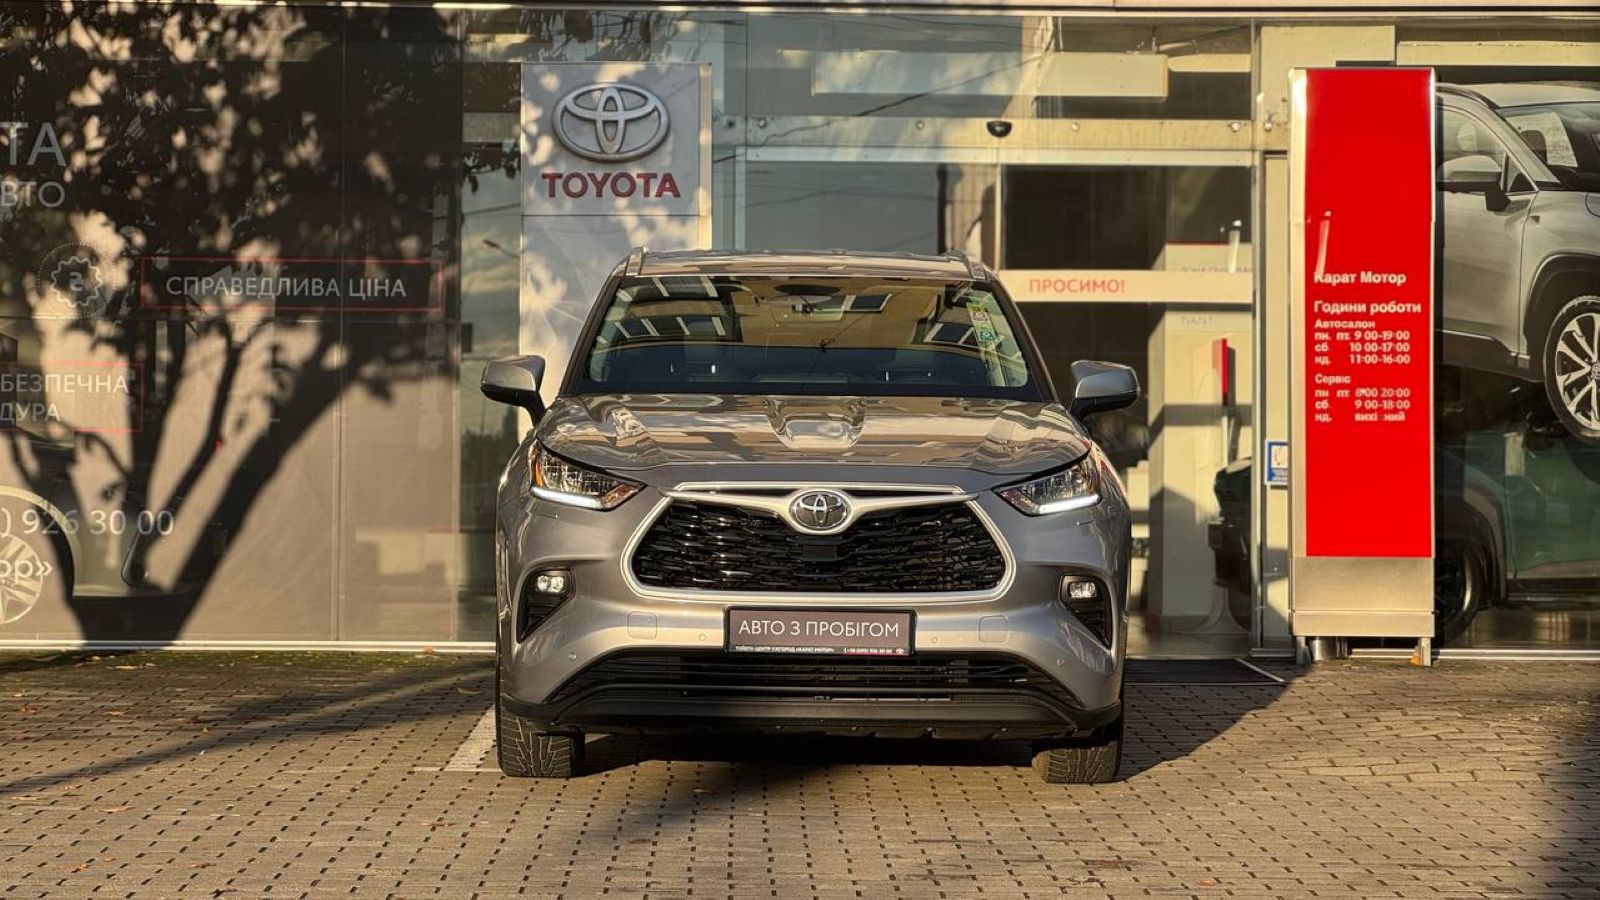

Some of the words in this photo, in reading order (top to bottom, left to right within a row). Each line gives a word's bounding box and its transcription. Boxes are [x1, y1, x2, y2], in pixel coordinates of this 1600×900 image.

[541, 172, 680, 198] TOYOTA
[1029, 278, 1126, 294] ПРОСИМО!
[1314, 272, 1357, 285] Карат
[1360, 271, 1407, 285] Мотор
[166, 276, 340, 297] СПРАВЕДЛИВА
[349, 279, 407, 300] ЦІНА
[1314, 301, 1367, 314] Години
[1370, 301, 1422, 315] роботи
[1315, 319, 1376, 329] Автосалон
[0, 374, 129, 393] БЕЗПЕЧНА
[22, 509, 80, 534] 926
[90, 509, 126, 535] 30
[138, 509, 174, 535] 00
[738, 620, 786, 636] АВТО
[806, 621, 899, 638] ПРОБІГОМ
